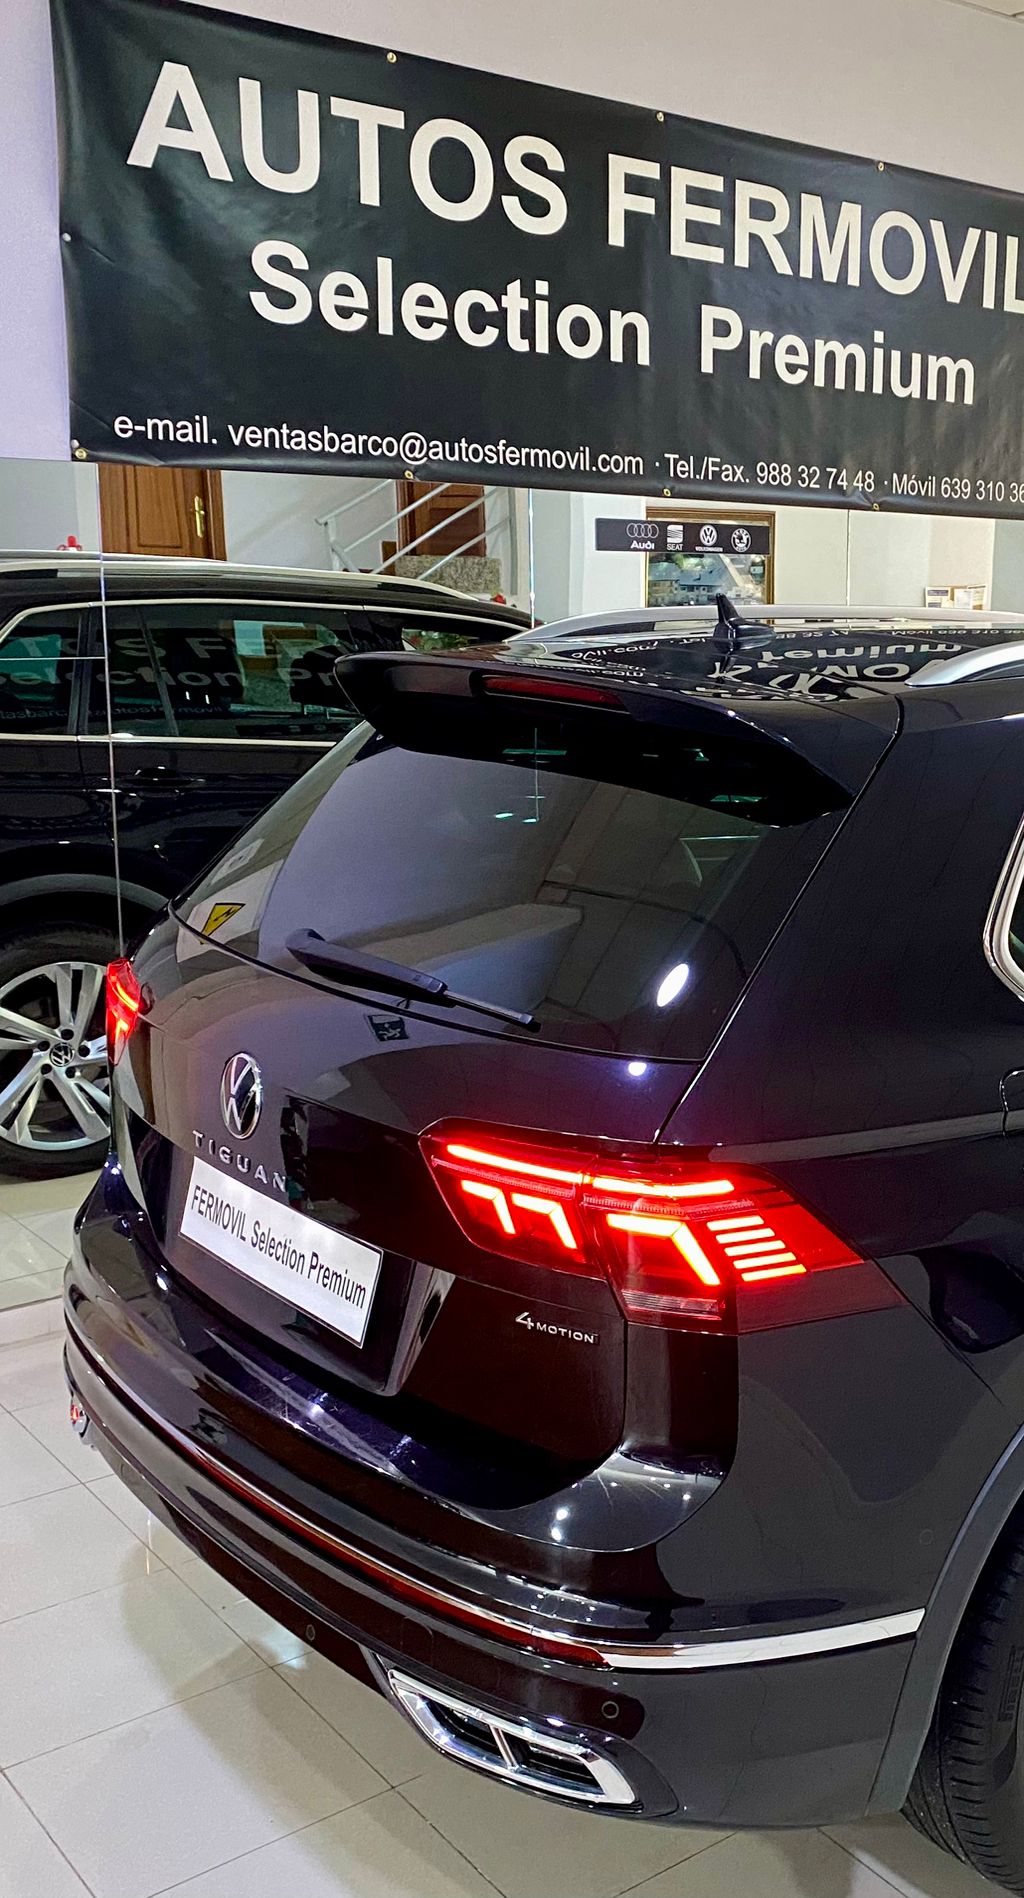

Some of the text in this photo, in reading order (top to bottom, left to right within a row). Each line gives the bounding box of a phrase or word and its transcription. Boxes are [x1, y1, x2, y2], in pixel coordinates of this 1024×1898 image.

[127, 61, 568, 235] AUTOS
[249, 239, 975, 405] Selection Premium
[114, 414, 217, 445] e-mail.
[228, 422, 644, 475] ventasbarco@autosfermovil.com
[756, 461, 792, 486] 988
[797, 465, 821, 489] 32
[826, 467, 848, 490] 74
[853, 470, 875, 492] 48
[940, 477, 971, 500] 639
[975, 480, 1005, 502] 310
[630, 540, 655, 550] Audi
[666, 543, 684, 551] SEAT
[192, 1130, 287, 1193] TIGUAN
[191, 1184, 366, 1309] FERMOVIL Selection Premium
